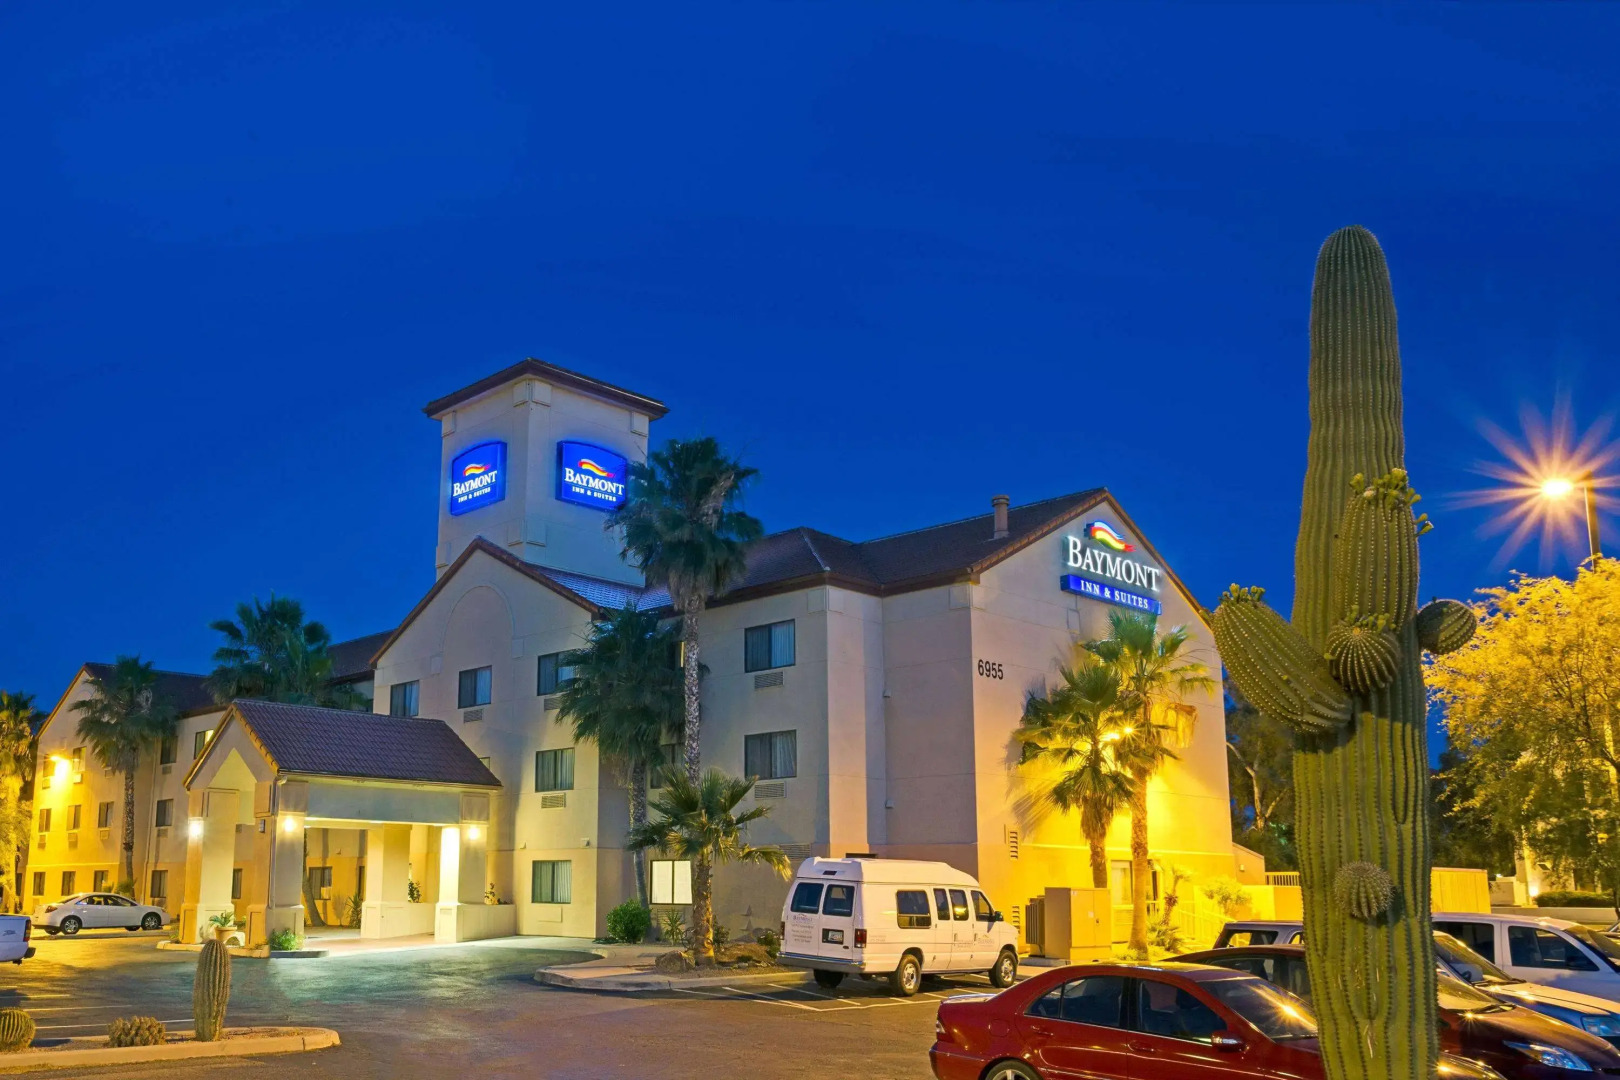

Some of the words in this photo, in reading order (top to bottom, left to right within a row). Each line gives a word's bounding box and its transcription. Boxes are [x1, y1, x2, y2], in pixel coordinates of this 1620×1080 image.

[453, 470, 498, 497] BAYMONT
[564, 467, 625, 495] BAYMONT
[572, 486, 585, 494] INN
[593, 491, 617, 502] SUITES
[1066, 535, 1160, 592] BAYMONT
[1080, 579, 1100, 595] INN
[1104, 587, 1111, 598] &
[1114, 590, 1149, 609] SUITES
[977, 658, 1004, 681] 6955
